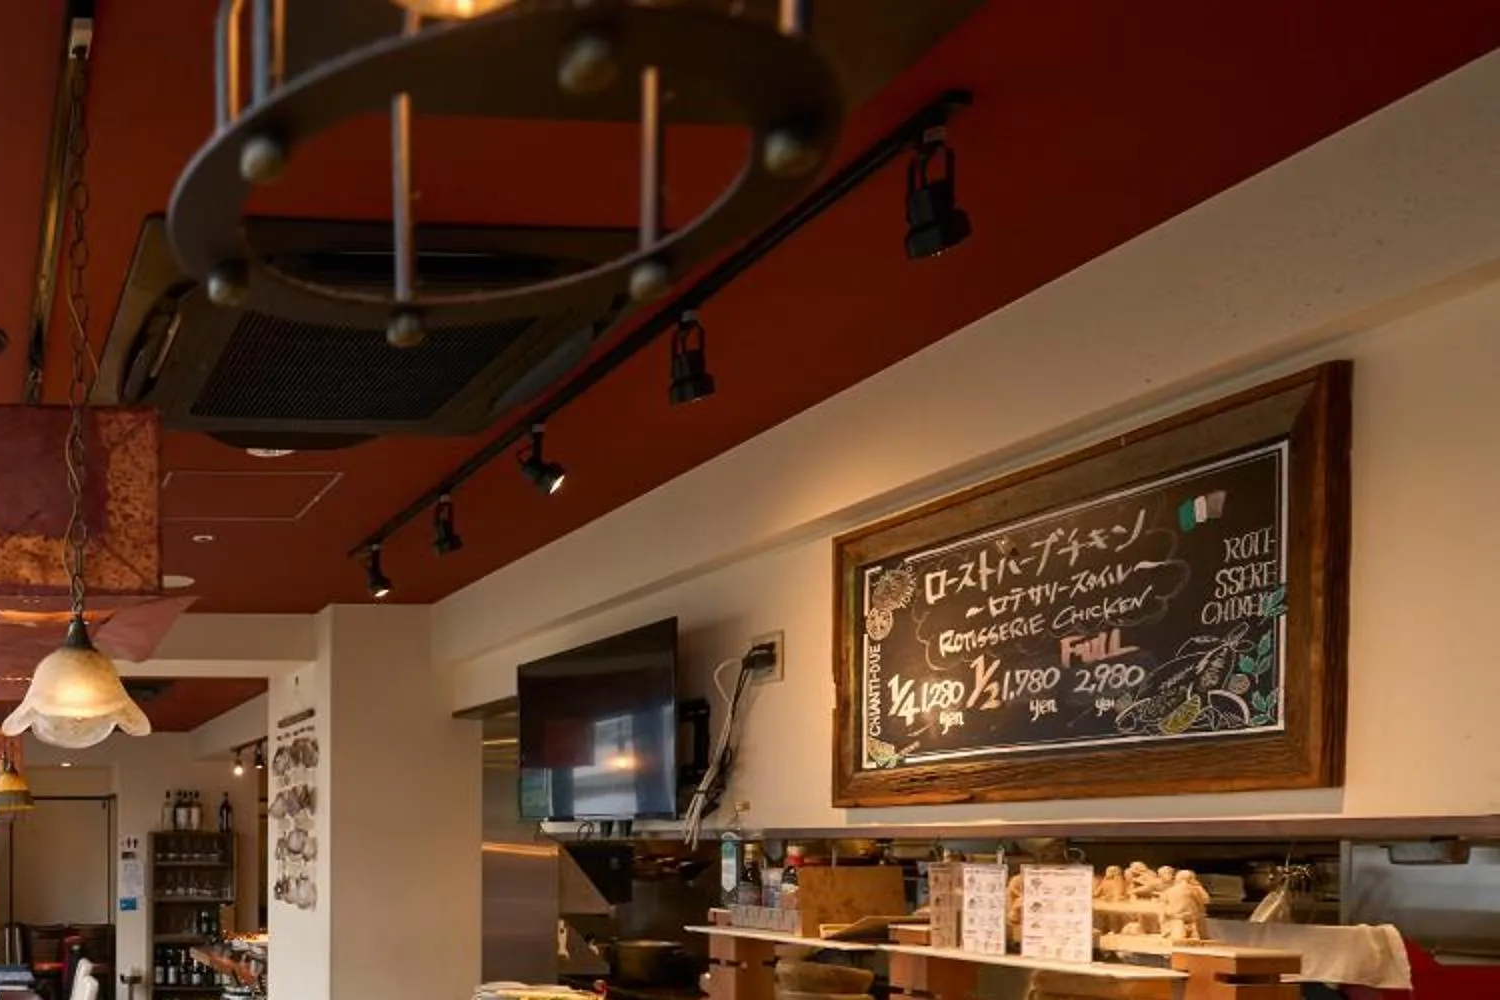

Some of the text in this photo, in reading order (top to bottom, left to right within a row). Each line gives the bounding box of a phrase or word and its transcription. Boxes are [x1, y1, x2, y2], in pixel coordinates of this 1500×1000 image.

[925, 508, 1146, 606] ローストハーブチキン
[939, 585, 1153, 657] ROTISSERIE CHICKEN
[1060, 627, 1141, 669] FULL
[869, 643, 882, 737] CHIANTI-DUE
[887, 673, 921, 727] 1/4
[965, 653, 1001, 711] 1/2
[939, 711, 964, 736] yen
[1029, 698, 1059, 722] yen
